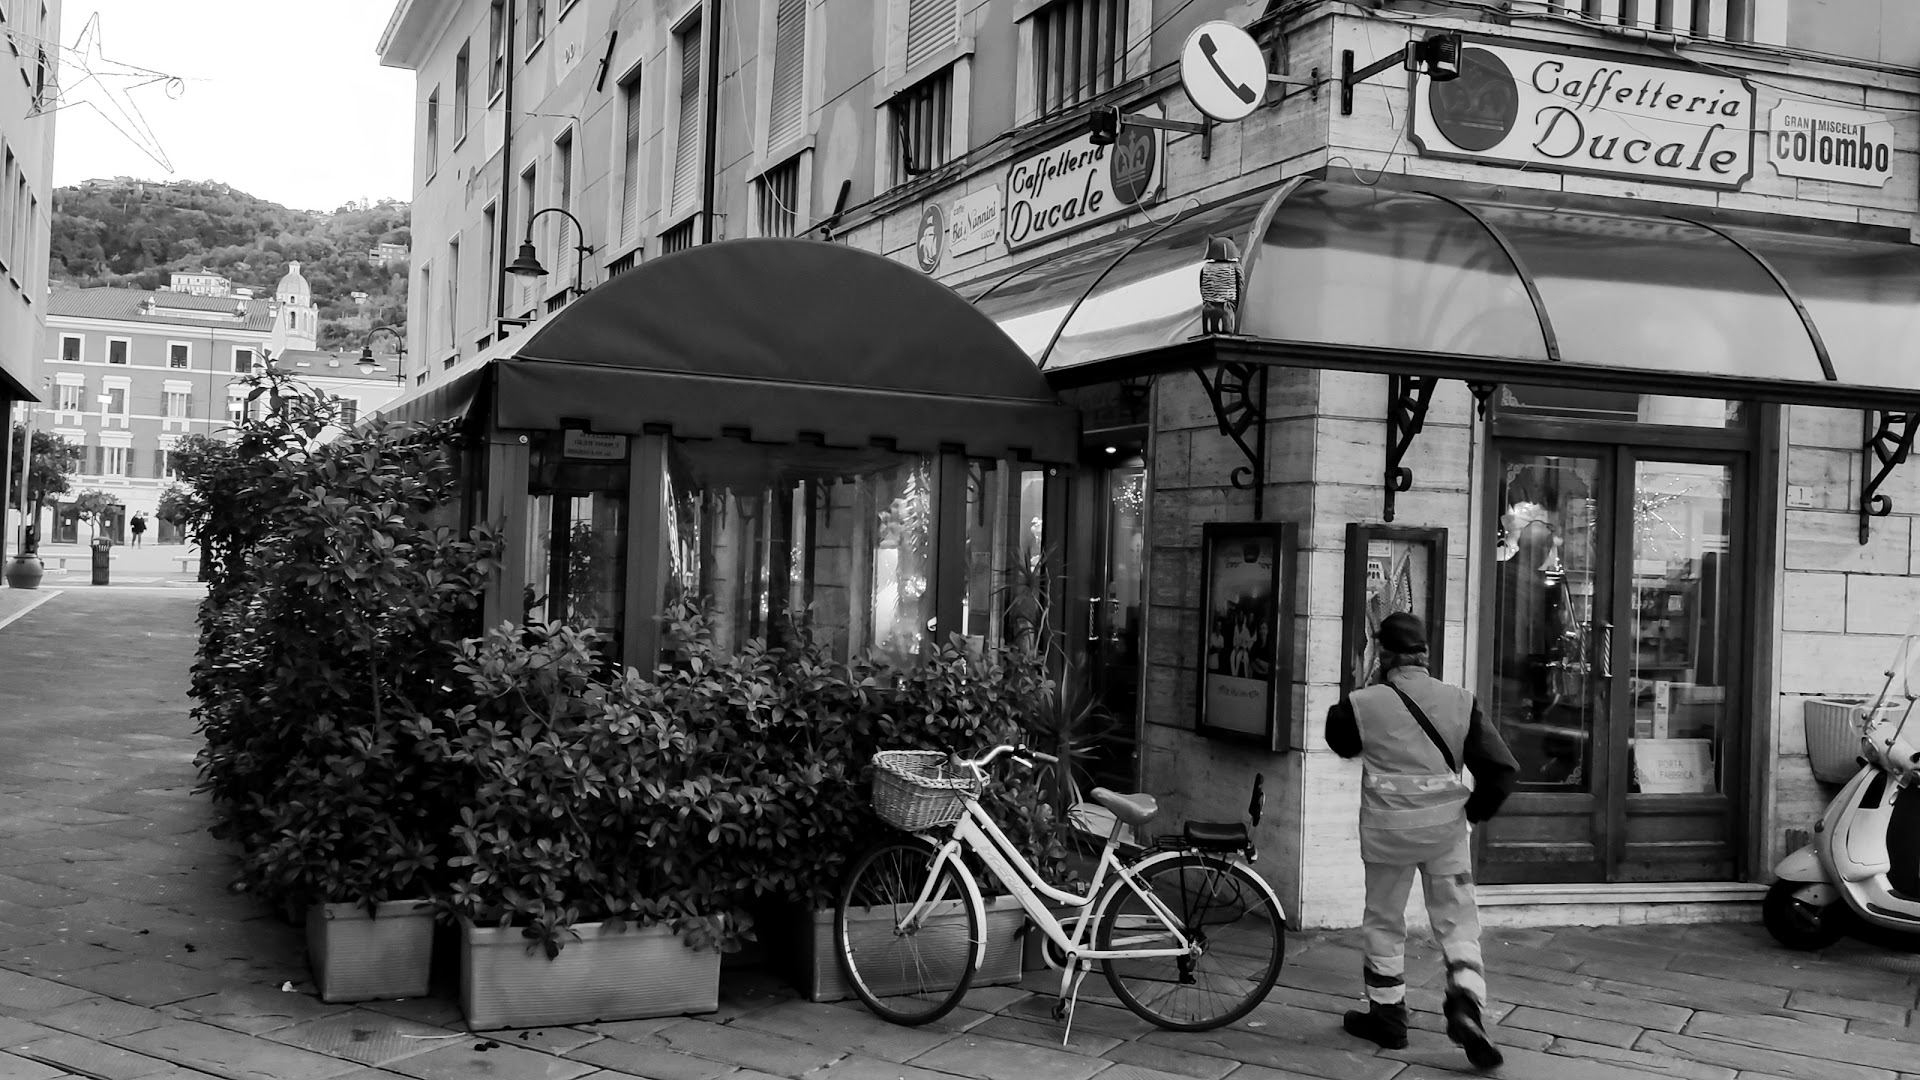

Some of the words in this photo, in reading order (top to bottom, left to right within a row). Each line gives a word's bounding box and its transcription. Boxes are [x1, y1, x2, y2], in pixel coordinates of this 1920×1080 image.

[1532, 60, 1740, 117] Caffetteria
[1532, 105, 1737, 174] Ducale
[1776, 118, 1889, 173] colombo
[1784, 115, 1810, 129] GRAN
[1818, 119, 1858, 136] MISCELA
[1012, 144, 1105, 199] Caffetteria
[1009, 168, 1104, 242] Ducale
[980, 228, 995, 240] LUCCA
[1799, 488, 1803, 500] 1
